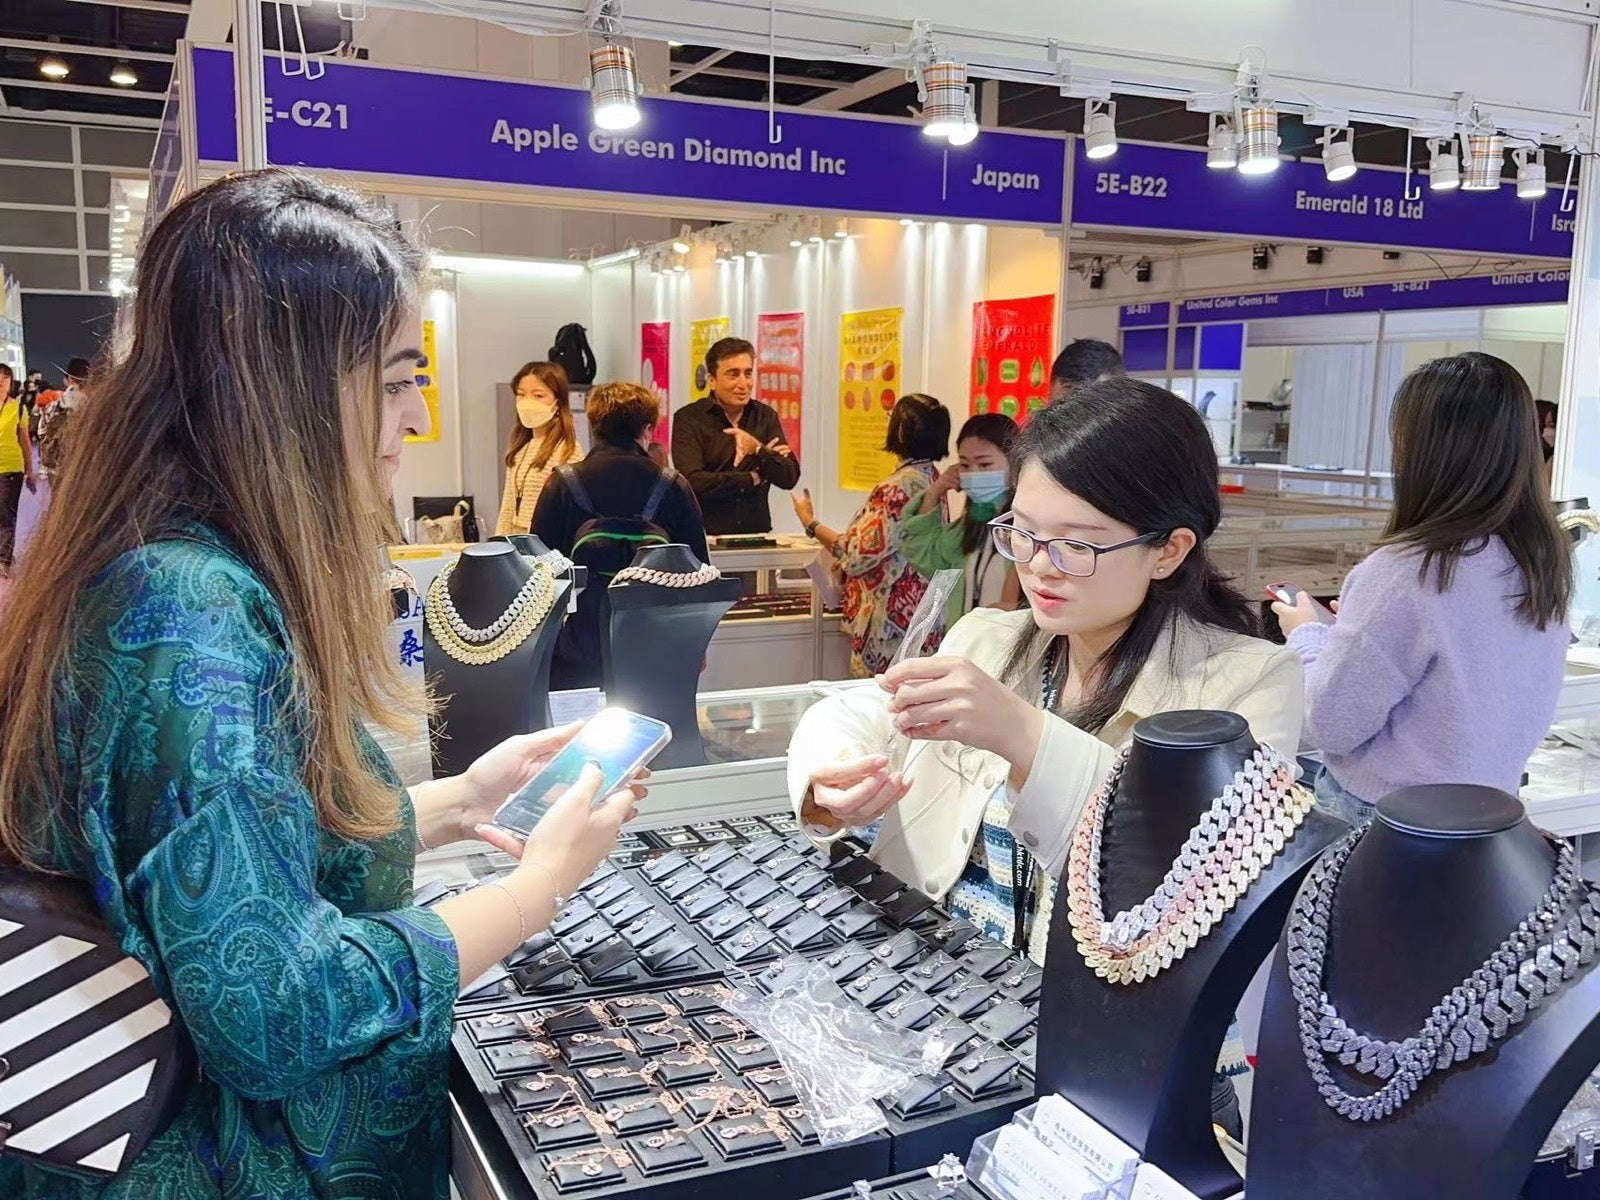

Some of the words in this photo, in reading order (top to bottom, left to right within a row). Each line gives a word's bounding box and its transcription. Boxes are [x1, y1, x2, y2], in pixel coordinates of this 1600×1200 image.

[491, 119, 579, 153] Apple
[588, 127, 675, 160] Green
[684, 138, 802, 172] Diamond
[811, 151, 847, 175] Inc
[972, 164, 1040, 192] Japan
[1095, 172, 1168, 198] 5E-B22
[1295, 191, 1368, 216] Emerald
[1374, 198, 1395, 218] 18
[1399, 199, 1424, 220] Ltd
[1491, 271, 1534, 286] United
[1186, 299, 1213, 311] United
[1214, 297, 1237, 308] Color
[1238, 295, 1263, 306] Gems
[1265, 294, 1279, 305] Inc
[1343, 287, 1364, 298] USA
